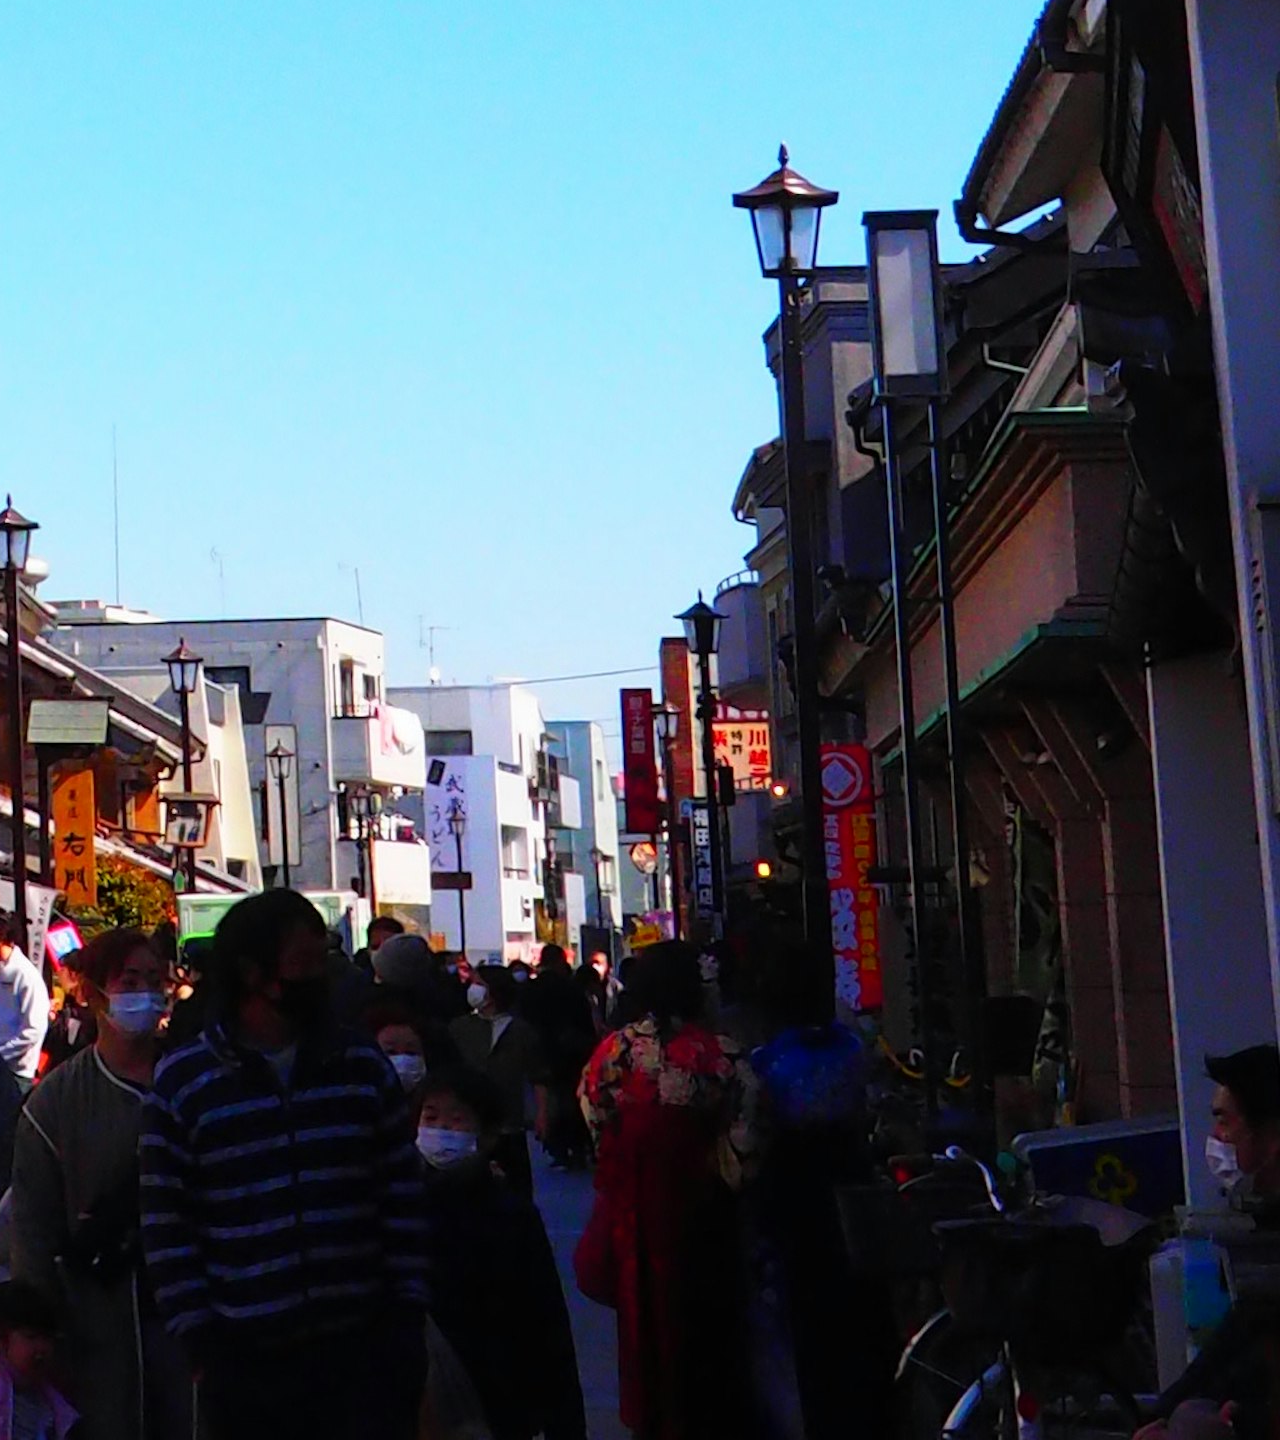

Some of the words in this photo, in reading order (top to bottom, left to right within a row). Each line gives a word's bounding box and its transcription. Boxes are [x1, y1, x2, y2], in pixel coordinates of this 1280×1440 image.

[62, 831, 88, 893] 右門
[429, 803, 445, 868] うどん
